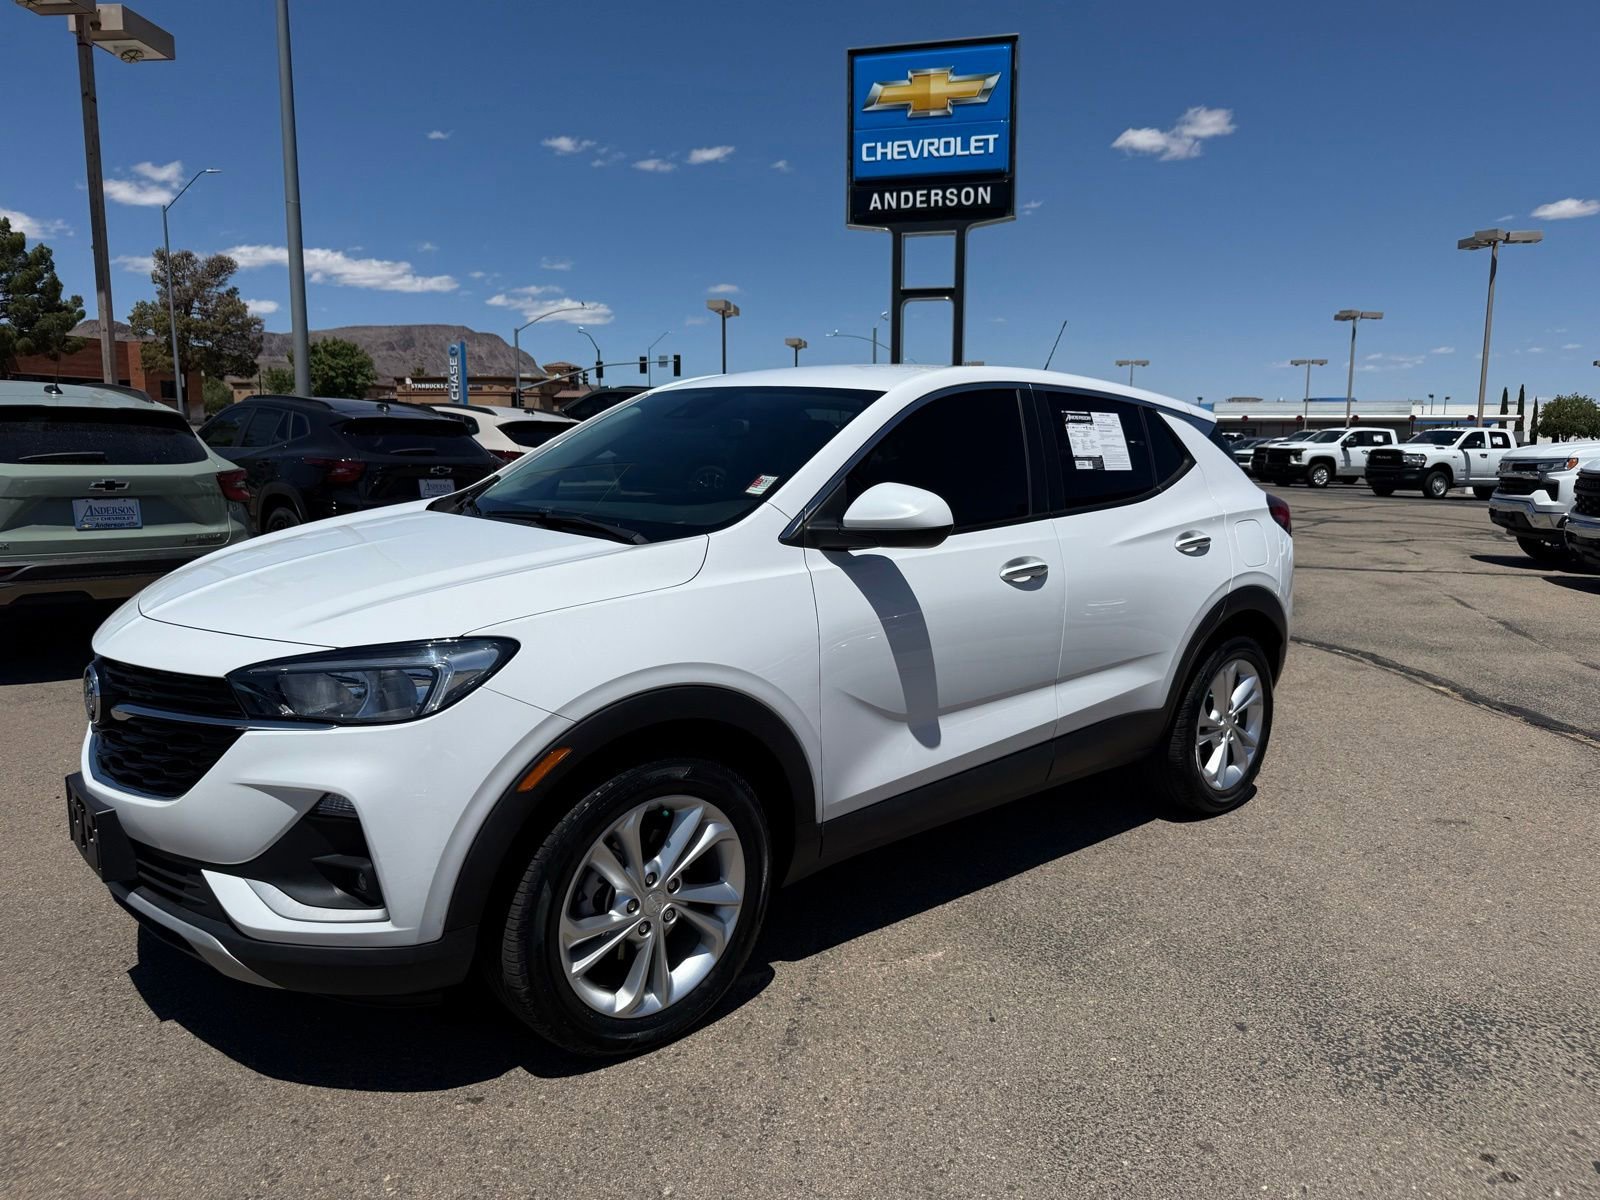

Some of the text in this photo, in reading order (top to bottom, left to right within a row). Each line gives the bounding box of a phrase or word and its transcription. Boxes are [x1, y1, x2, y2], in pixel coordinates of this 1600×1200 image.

[861, 134, 999, 162] CHEVROLET
[869, 186, 991, 211] ANDERSON
[450, 357, 459, 401] CHASE
[80, 504, 136, 522] ANDERSON
